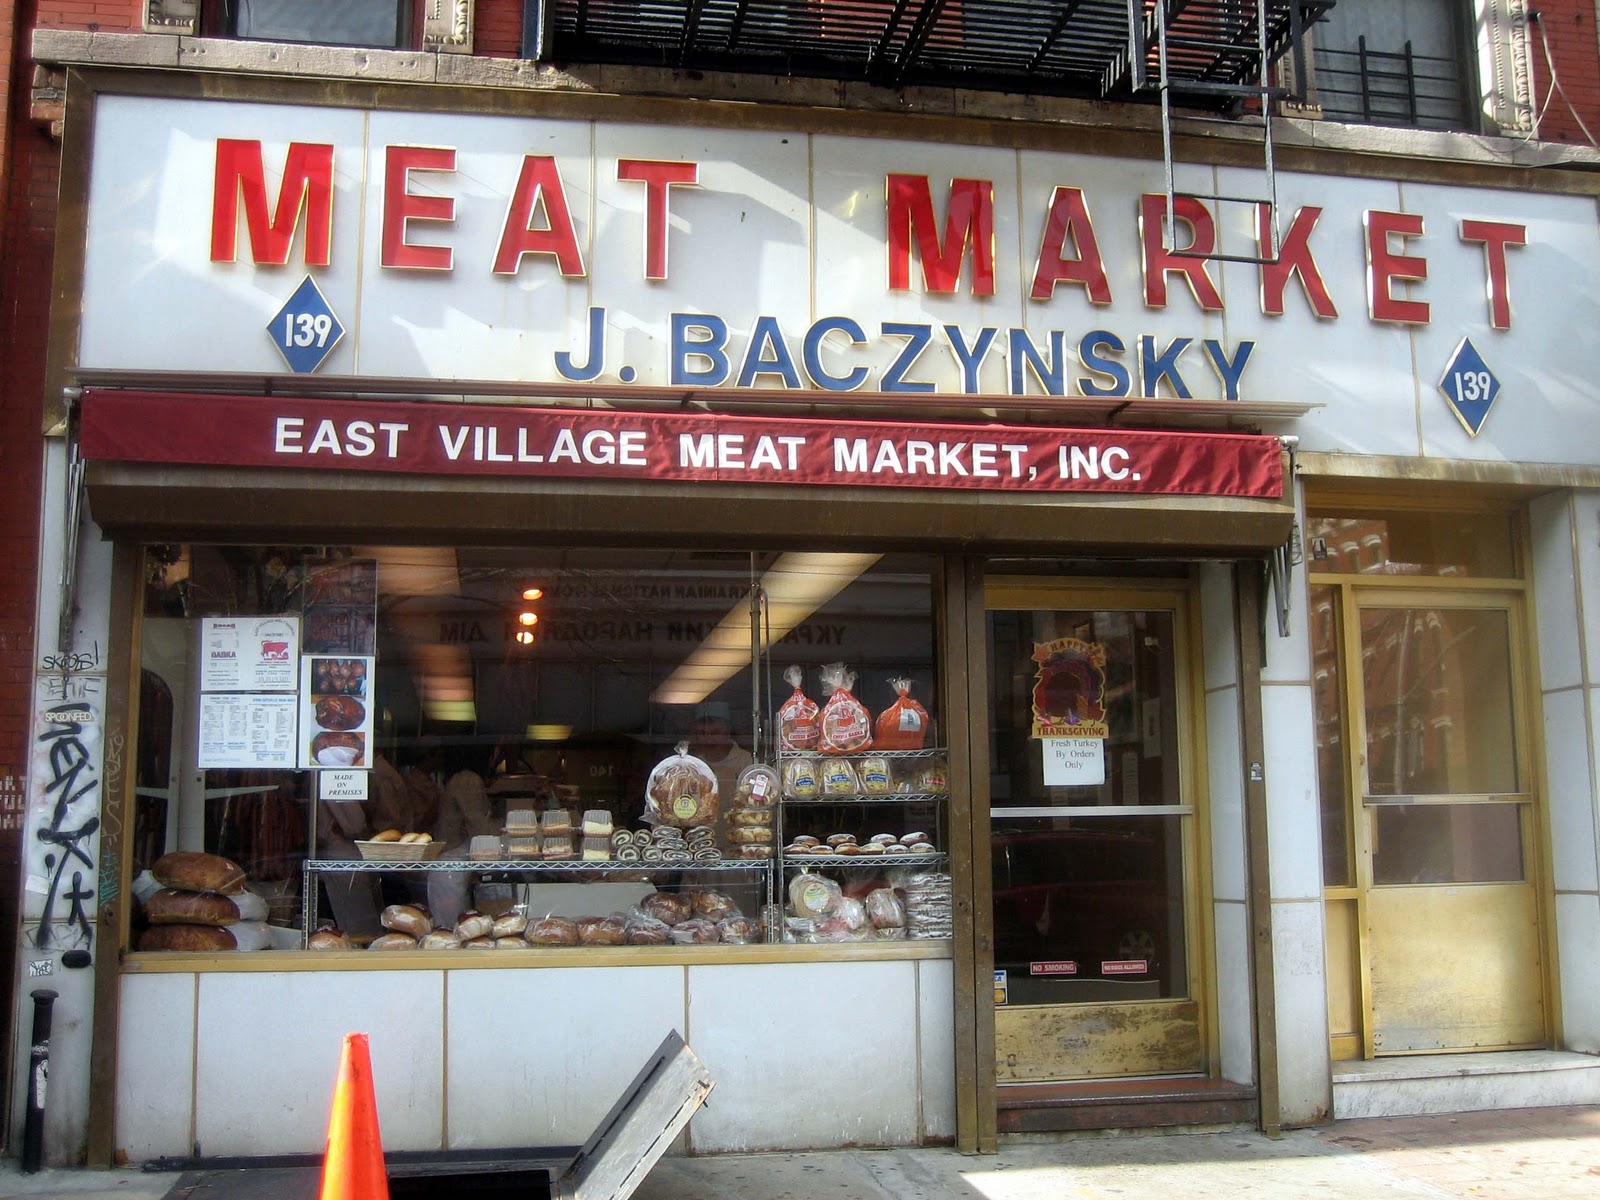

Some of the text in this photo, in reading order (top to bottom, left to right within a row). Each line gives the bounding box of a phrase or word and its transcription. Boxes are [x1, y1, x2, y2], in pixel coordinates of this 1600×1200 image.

[209, 137, 1528, 330] MEAT MARKET
[285, 313, 333, 349] 139
[554, 306, 1257, 401] J. BACZYNSKY
[1454, 371, 1491, 403] 139
[274, 416, 1141, 482] EAST VILLAGE MEAT MARKET, INC.
[1051, 639, 1086, 652] HAPPY
[1037, 727, 1104, 736] THANKSGIVING
[1073, 740, 1099, 748] Turkey
[1056, 750, 1095, 759] By Orders
[1065, 761, 1083, 769] Only
[1033, 964, 1042, 972] NO
